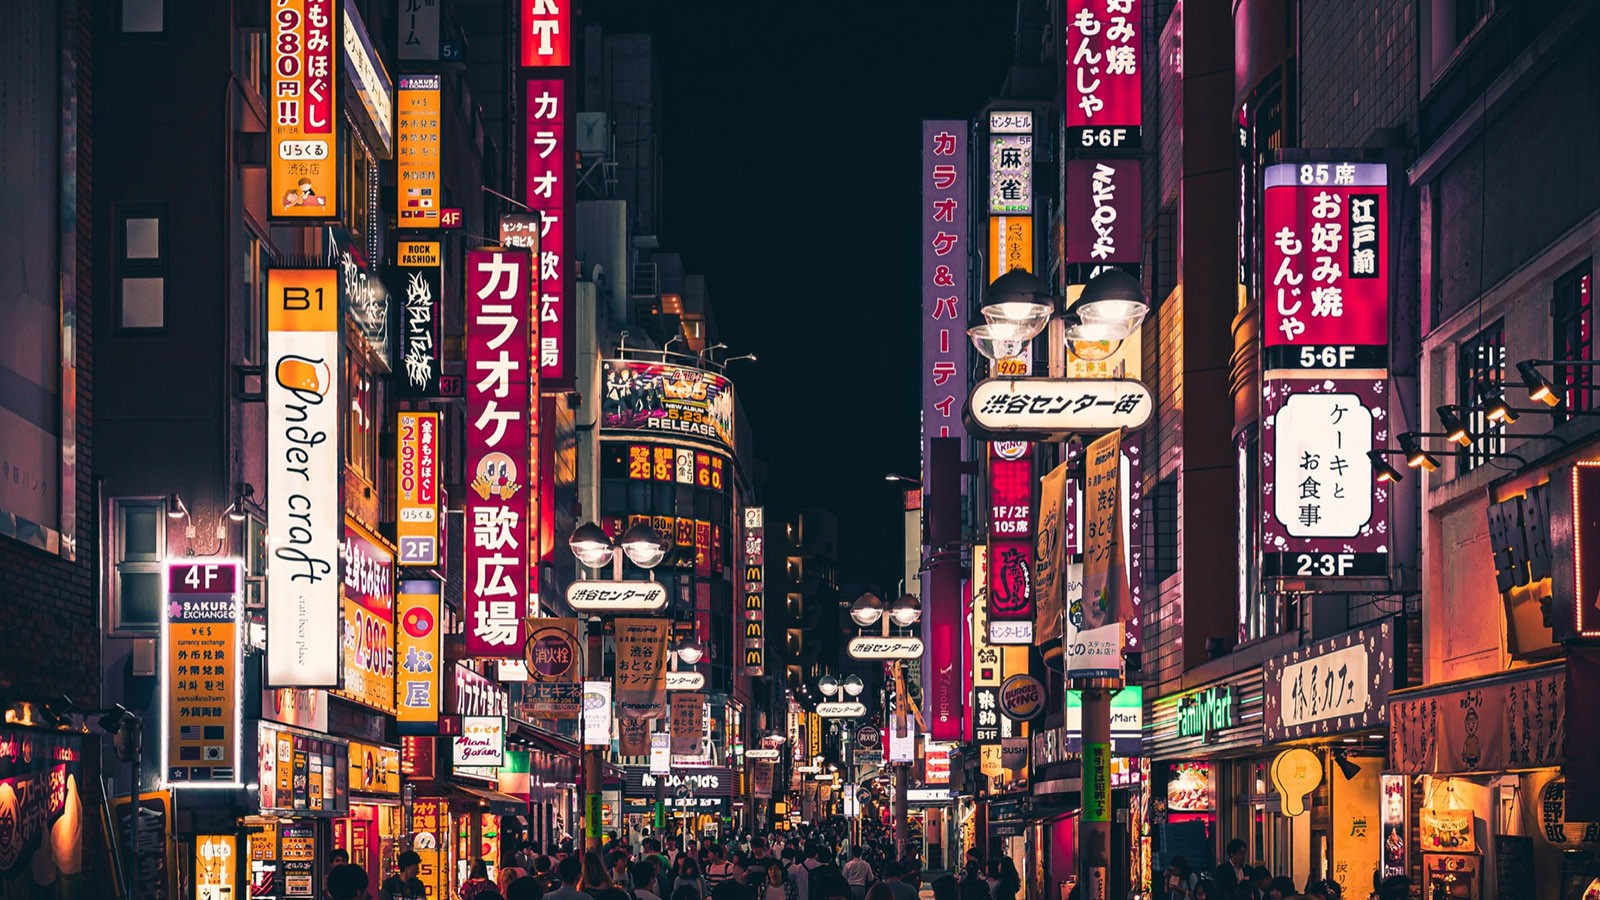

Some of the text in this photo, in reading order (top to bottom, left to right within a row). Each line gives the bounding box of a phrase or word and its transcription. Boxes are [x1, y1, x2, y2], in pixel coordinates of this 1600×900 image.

[307, 0, 329, 128] もみほぐし
[1073, 8, 1104, 117] もんじゃ
[991, 116, 1031, 128] センタービル
[1019, 137, 1031, 145] 5F
[283, 144, 324, 157] りらくる
[288, 163, 320, 176] 渋谷店
[1000, 147, 1022, 201] 麻雀
[1300, 163, 1356, 185] 85席
[441, 212, 460, 225] 4F
[1352, 199, 1375, 275] 江戸前
[408, 245, 430, 255] ROCK
[1311, 191, 1343, 317] お好み焼
[402, 255, 436, 264] FASHION
[1273, 226, 1306, 341] もんじゃ
[283, 287, 323, 311] B1
[474, 253, 520, 447] カラオケ
[442, 378, 460, 393] 3F
[980, 393, 1144, 415] 渋谷センター街
[648, 417, 716, 437] RELEASE
[1329, 404, 1349, 499] ケーキと
[1298, 450, 1322, 527] お食事
[402, 510, 432, 520] りらくる
[992, 506, 1029, 519] 1F/2F
[994, 520, 1028, 533] 105席
[276, 495, 331, 584] craft
[406, 541, 430, 558] 2F
[184, 564, 219, 589] 4F
[345, 541, 392, 609] 全身もみほぐし
[473, 506, 520, 647] 歌広場
[572, 589, 662, 602] 渋谷センター街
[183, 602, 236, 611] SAKURA
[990, 626, 1032, 638] センタービル
[630, 646, 654, 658] 渋谷
[853, 643, 921, 653] 渋谷センター街
[1068, 643, 1086, 656] この
[535, 648, 570, 664] 消火栓
[978, 649, 998, 664] 鍋
[619, 660, 663, 671] おとなり
[405, 648, 433, 707] 松屋
[619, 674, 663, 685] サンデー
[1005, 684, 1037, 700] BURGER
[621, 702, 661, 710] Panasonic
[1006, 693, 1040, 710] KING
[1176, 686, 1232, 744] FamilyMart
[455, 736, 491, 747] Miami
[977, 731, 998, 741] B1F
